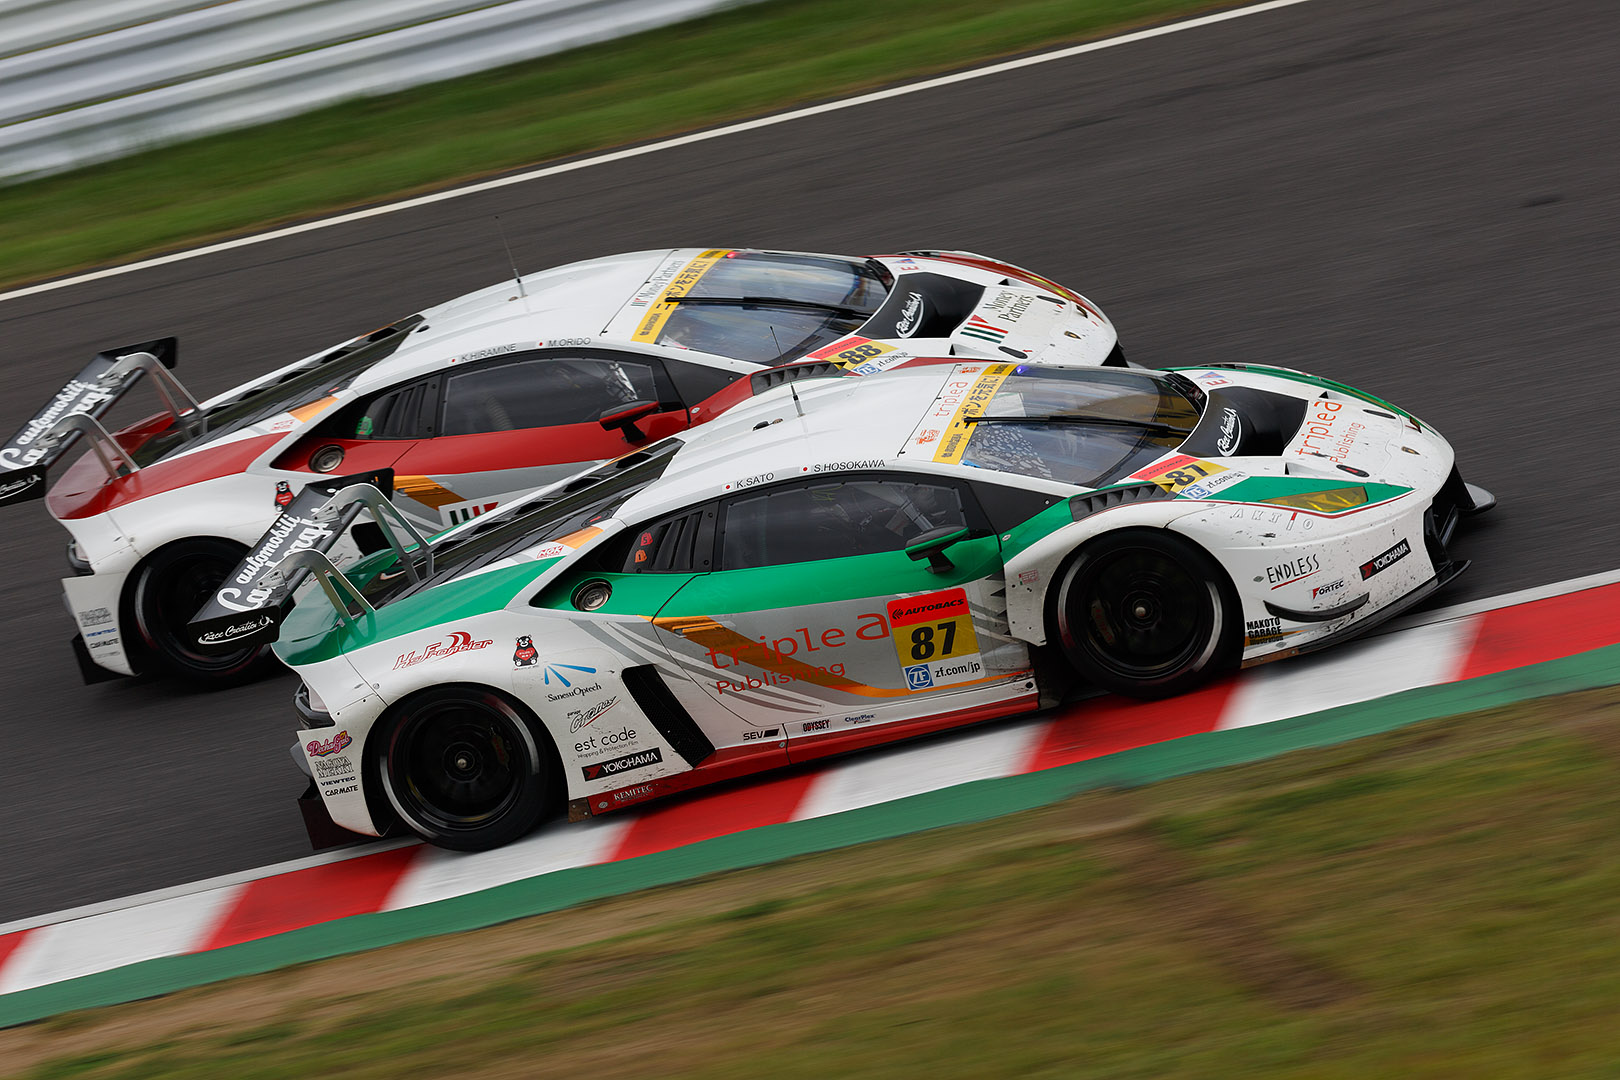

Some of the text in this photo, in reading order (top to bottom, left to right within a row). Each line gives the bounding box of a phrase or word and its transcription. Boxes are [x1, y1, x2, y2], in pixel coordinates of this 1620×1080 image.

[983, 289, 1020, 312] Money
[998, 294, 1034, 324] Partners
[461, 343, 517, 361] K.HIRAMINE
[547, 337, 592, 348] M.ORIDO
[838, 344, 882, 366] 88
[1329, 422, 1366, 465] Publishing
[813, 459, 886, 473] S.HOSOKAWA
[1164, 463, 1209, 487] 87
[735, 472, 775, 489] K.SATO
[236, 513, 301, 585] automobili
[1373, 542, 1409, 570] YOKOHAMA
[1266, 553, 1320, 584] ENDLESS
[1313, 580, 1344, 601] FORTEC
[904, 598, 965, 617] AUTOBACS
[1246, 616, 1281, 631] MAKOTO
[1247, 625, 1283, 640] GARAGE
[909, 619, 957, 661] 87
[715, 659, 847, 696] Publishing
[933, 662, 981, 679] zf.com/jp
[547, 683, 603, 702] SanesuOptech
[802, 719, 831, 732] ODYSSEY
[574, 726, 637, 753] est code
[743, 730, 764, 741] SEV
[602, 752, 658, 774] YOKOHAMA
[320, 775, 357, 787] VIEWTEC
[325, 784, 359, 797] CARMATE
[613, 784, 654, 801] KEMITEC
